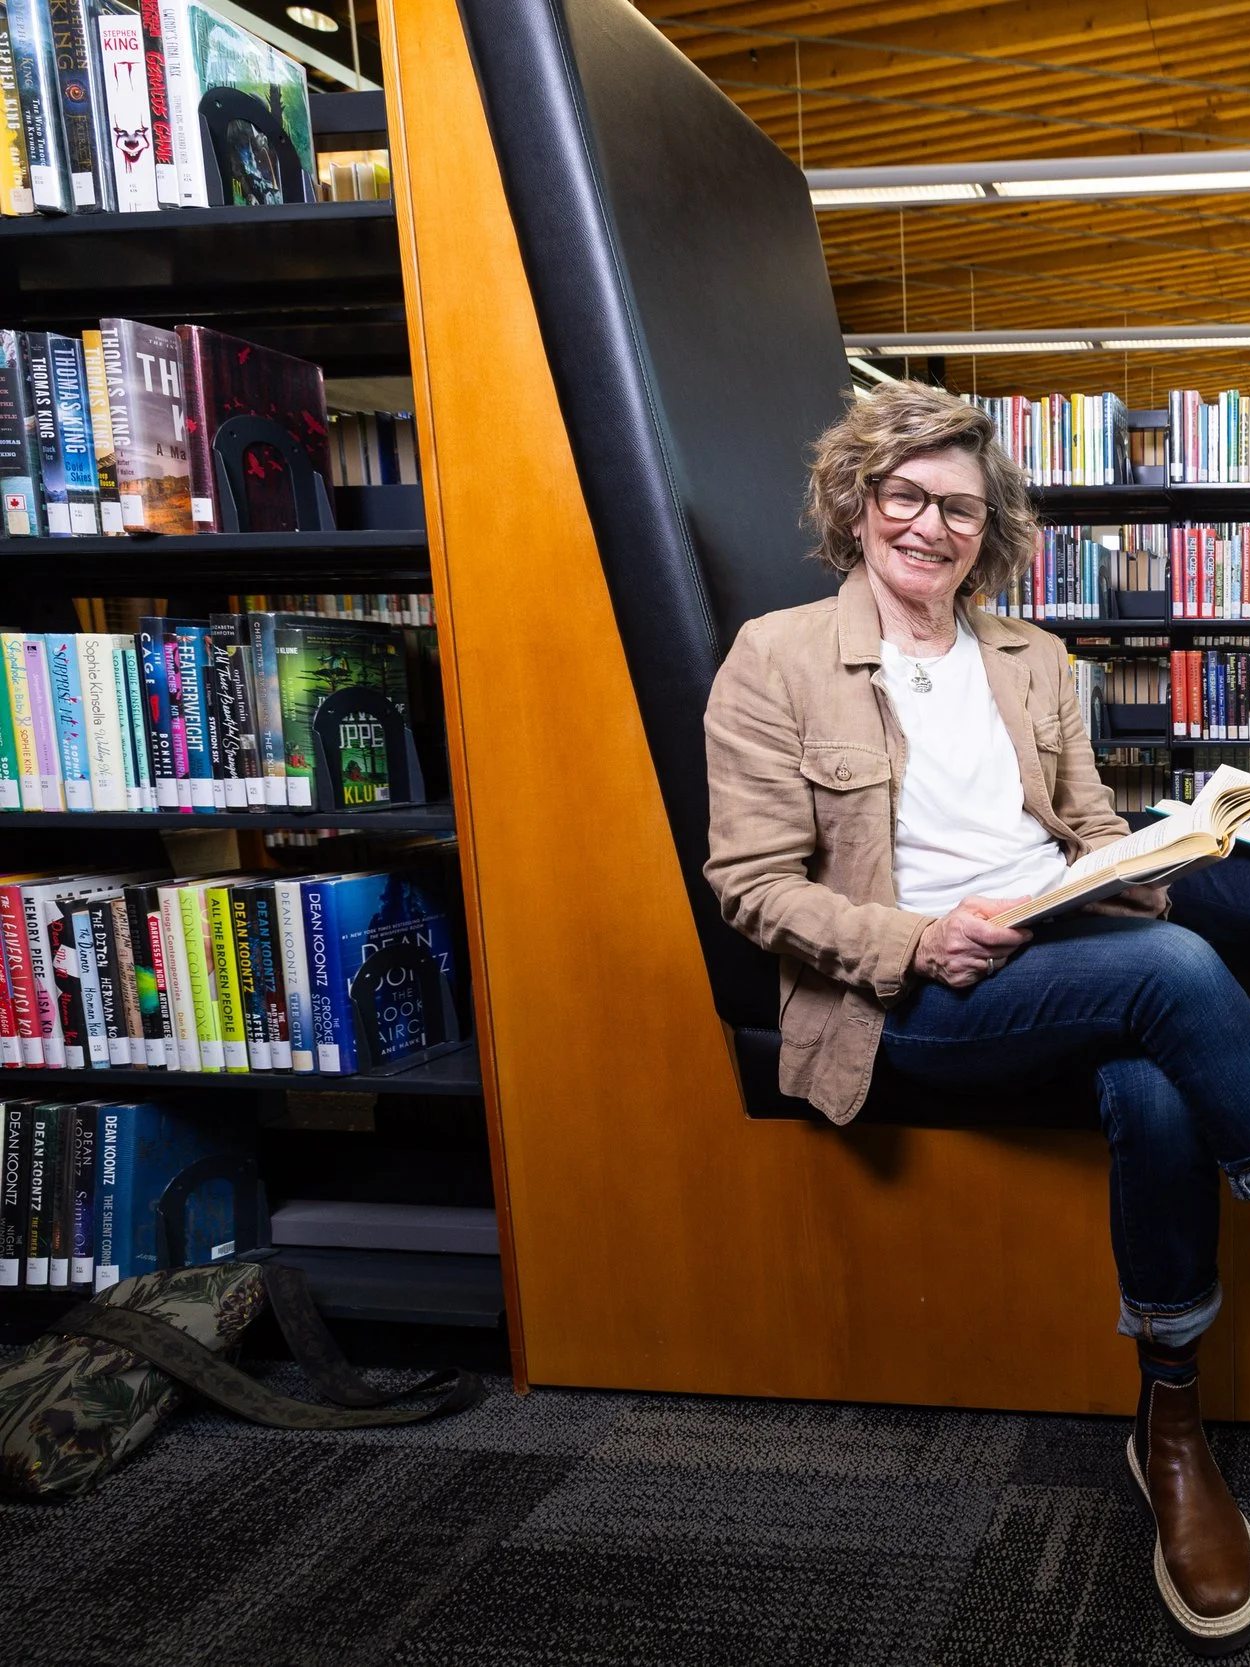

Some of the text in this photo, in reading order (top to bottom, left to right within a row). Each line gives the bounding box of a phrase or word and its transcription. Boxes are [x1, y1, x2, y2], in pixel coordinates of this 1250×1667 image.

[104, 38, 139, 51] KING
[113, 61, 140, 91] IT
[32, 357, 55, 439] THOMAS KING
[54, 348, 86, 454] THOMAS KING
[102, 327, 131, 447] THOMAS KING
[83, 640, 103, 726] Sophie Kinsella
[127, 655, 142, 728] SOPHIE KINSELLA
[141, 632, 156, 685] CAGE
[178, 645, 204, 753] FEATHERWEIGHT
[159, 733, 173, 776] BONNIE
[208, 716, 220, 764] STATION SIX
[24, 897, 45, 979] MEMORY PIECE
[91, 909, 108, 968] THE DITCH
[163, 899, 181, 1001] Vintage Contemporaries
[210, 898, 236, 1034] ALL THE BROKEN PEOPLE
[234, 902, 255, 994] DEAN KOONTZ
[257, 901, 277, 993] DEAN KOONTZ
[280, 892, 298, 985] DEAN KOONTZ
[308, 893, 329, 987] DEAN KOONTZ
[36, 990, 53, 1035] LISA KO
[252, 1014, 264, 1044] AFTER
[290, 993, 303, 1048] THE CITY
[5, 1111, 22, 1206] DEAN KOONTZ
[31, 1121, 46, 1212] DEAN KOONTZ
[83, 1131, 94, 1166] DEAN
[103, 1115, 118, 1186] DEAN KOONTZ
